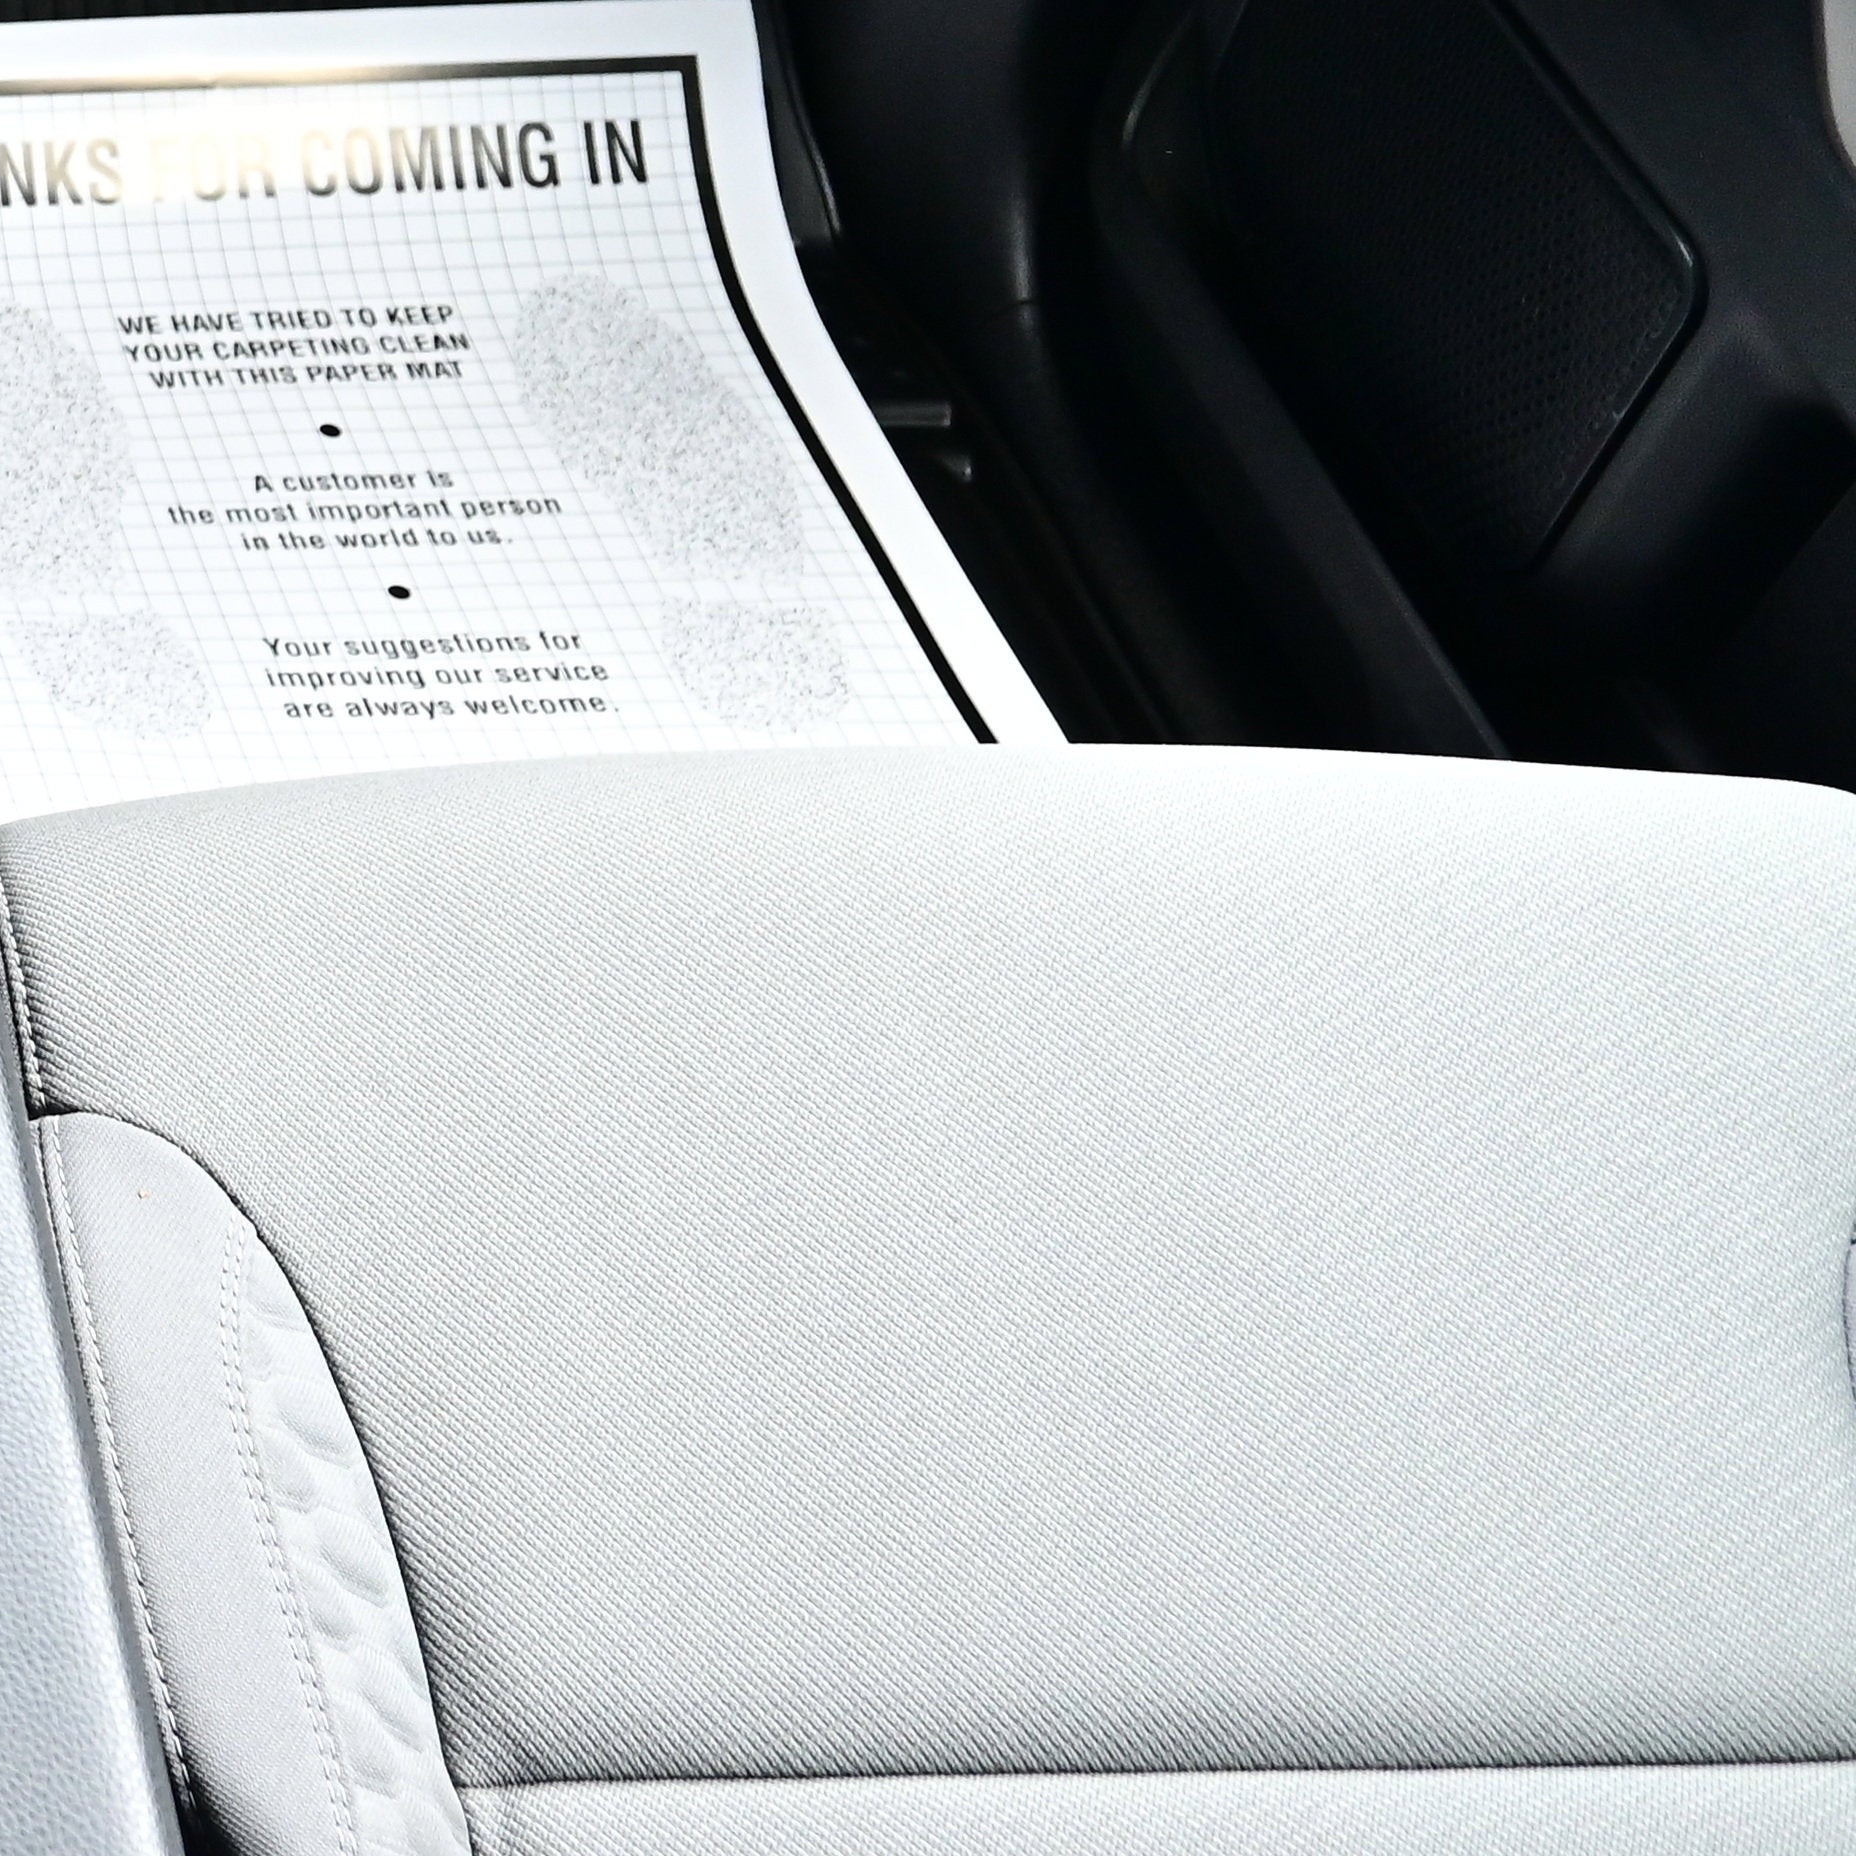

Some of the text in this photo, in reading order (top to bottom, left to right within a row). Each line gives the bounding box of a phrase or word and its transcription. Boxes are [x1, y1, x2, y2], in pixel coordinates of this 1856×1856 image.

[149, 132, 278, 205] OR
[300, 120, 563, 198] COMING
[583, 118, 650, 186] IN
[118, 304, 455, 335] WE HAVE TRIED TO KEEP
[122, 332, 473, 364] YOUR CARPETING CLEAN
[148, 360, 466, 391] WITH THIS PAPER MAT
[253, 468, 456, 494] A customer is
[168, 495, 563, 525] the most important person
[240, 526, 515, 552] in the world to us.
[262, 630, 582, 660] Your suggestions for
[265, 661, 610, 692] improving our service
[283, 693, 622, 721] are always welcome.
